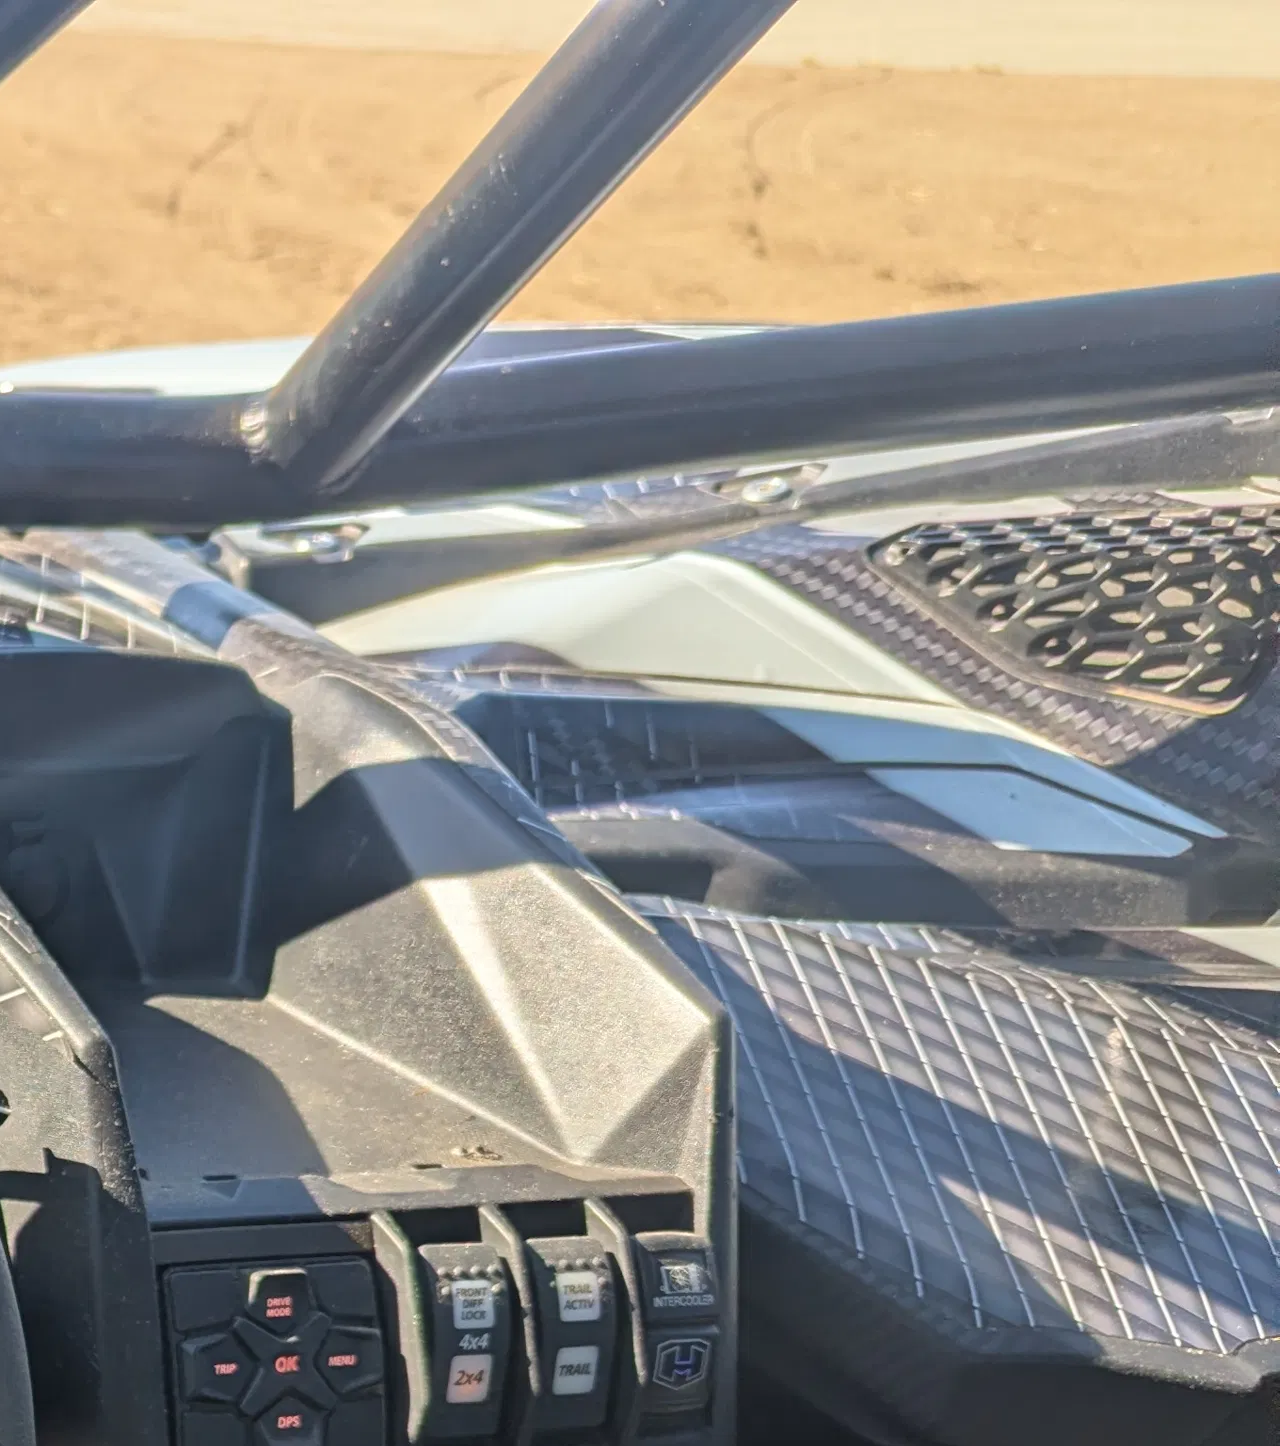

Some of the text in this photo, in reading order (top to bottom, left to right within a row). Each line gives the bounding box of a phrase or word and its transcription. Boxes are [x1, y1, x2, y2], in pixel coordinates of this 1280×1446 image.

[455, 1286, 488, 1298] FRONT
[562, 1283, 593, 1295] TRAIL
[266, 1296, 293, 1307] DRIVE
[462, 1298, 485, 1309] DIFF
[563, 1299, 595, 1311] ACTIV
[652, 1294, 715, 1309] INTERCOOLER
[265, 1307, 292, 1318] MODE
[460, 1310, 487, 1321] LOCK
[458, 1332, 490, 1351] 4x4
[213, 1354, 357, 1375] TRIP OK MENU
[558, 1363, 593, 1377] TRAIL
[453, 1368, 485, 1386] 2x4
[277, 1415, 302, 1429] DPS
